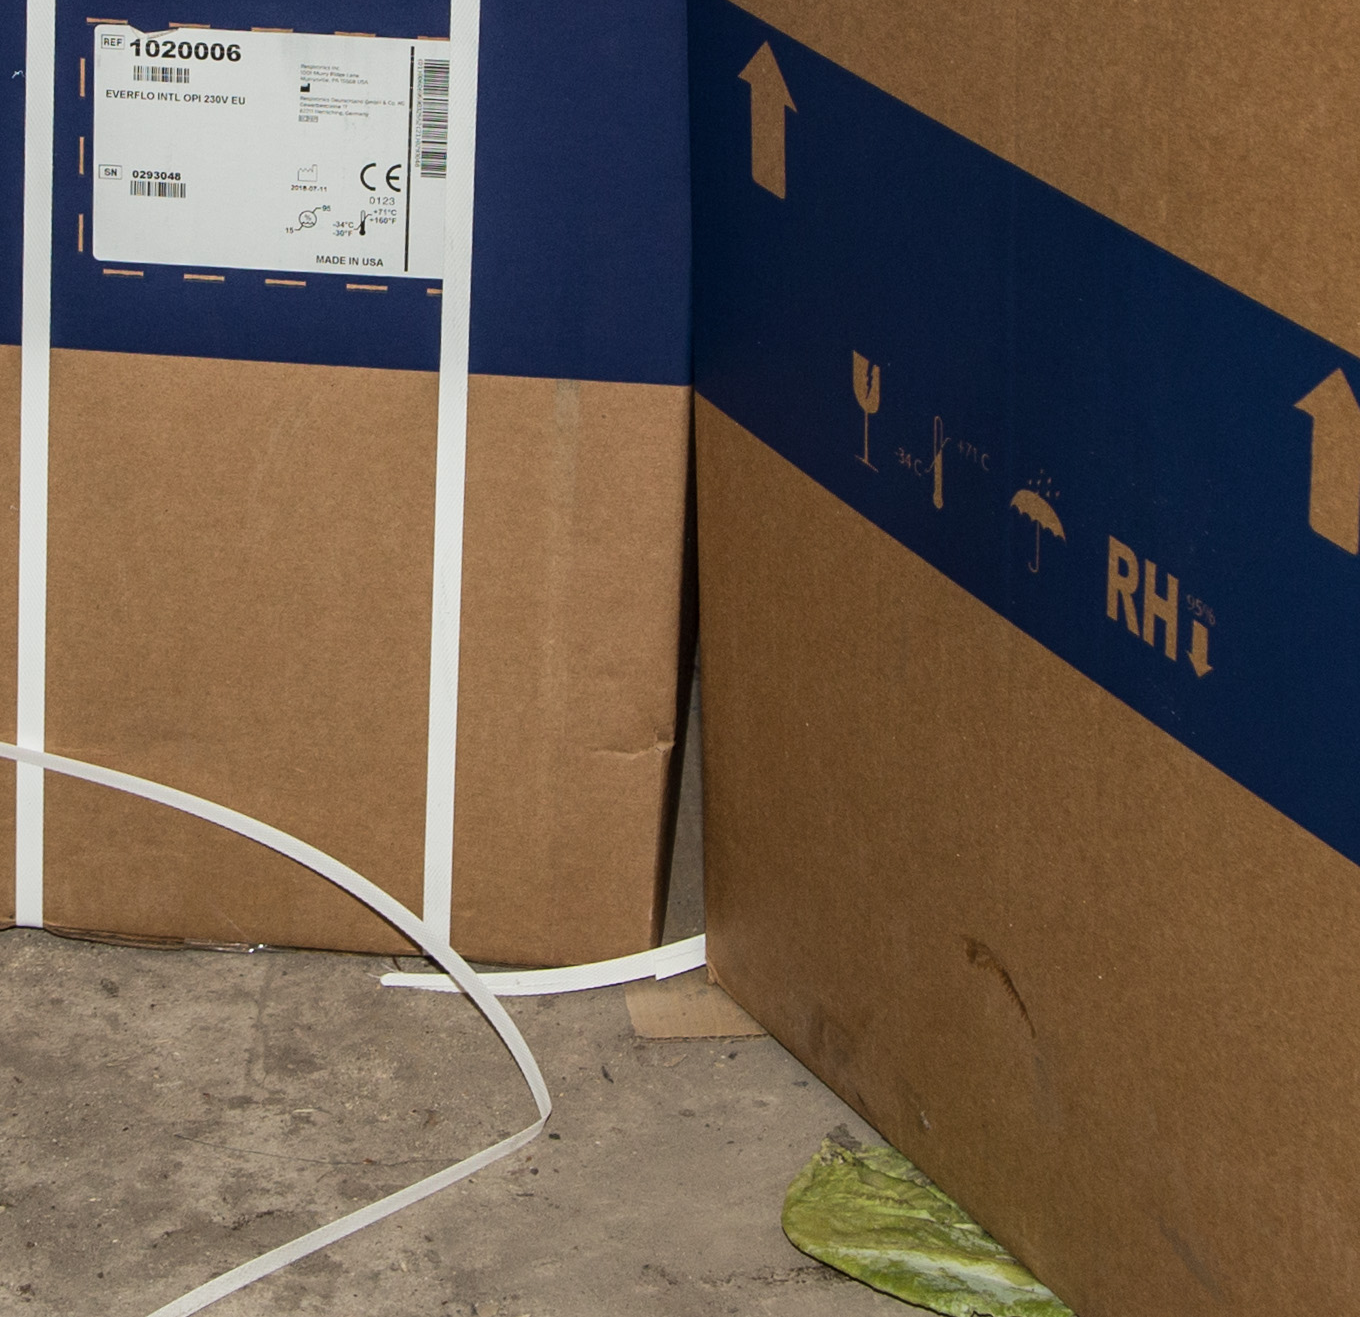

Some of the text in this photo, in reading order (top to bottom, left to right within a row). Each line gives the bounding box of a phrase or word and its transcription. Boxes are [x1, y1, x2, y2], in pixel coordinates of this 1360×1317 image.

[103, 37, 242, 63] REF 1020006
[105, 89, 246, 105] EVERFLO INTL OPI 230V EU
[103, 167, 182, 181] SN 0293048
[369, 196, 396, 206] 0123
[316, 255, 384, 267] MADE IN USA
[1106, 534, 1179, 662] RH
